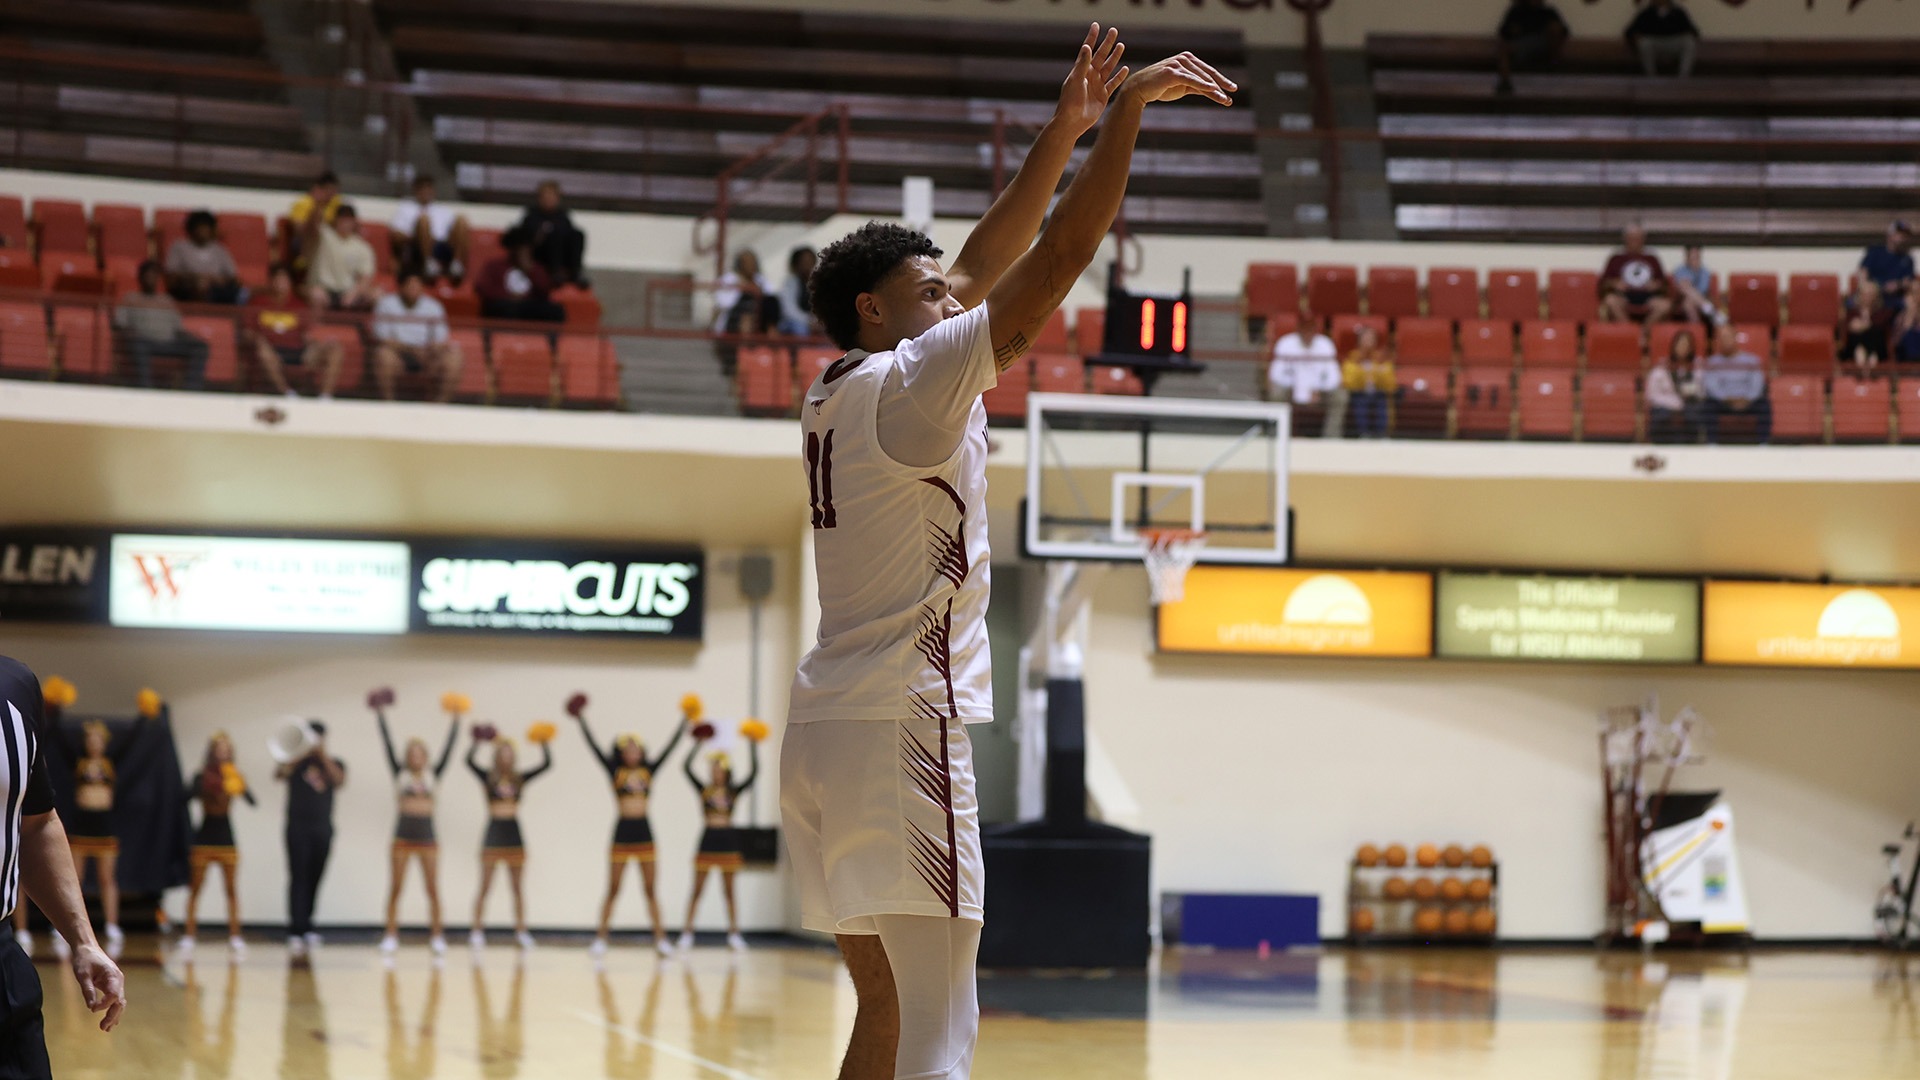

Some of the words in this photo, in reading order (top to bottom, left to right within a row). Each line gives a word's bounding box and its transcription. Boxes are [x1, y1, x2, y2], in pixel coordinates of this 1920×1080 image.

[1141, 298, 1187, 352] 11
[807, 428, 837, 529] 11
[419, 557, 691, 617] SUPERCUTS
[1518, 580, 1552, 605] The
[1554, 580, 1619, 606] Official
[1456, 604, 1517, 632] Sports
[1518, 606, 1600, 632] Medicine
[1602, 608, 1676, 634] Provider
[1490, 632, 1517, 656] for
[1566, 633, 1643, 659] Athletics
